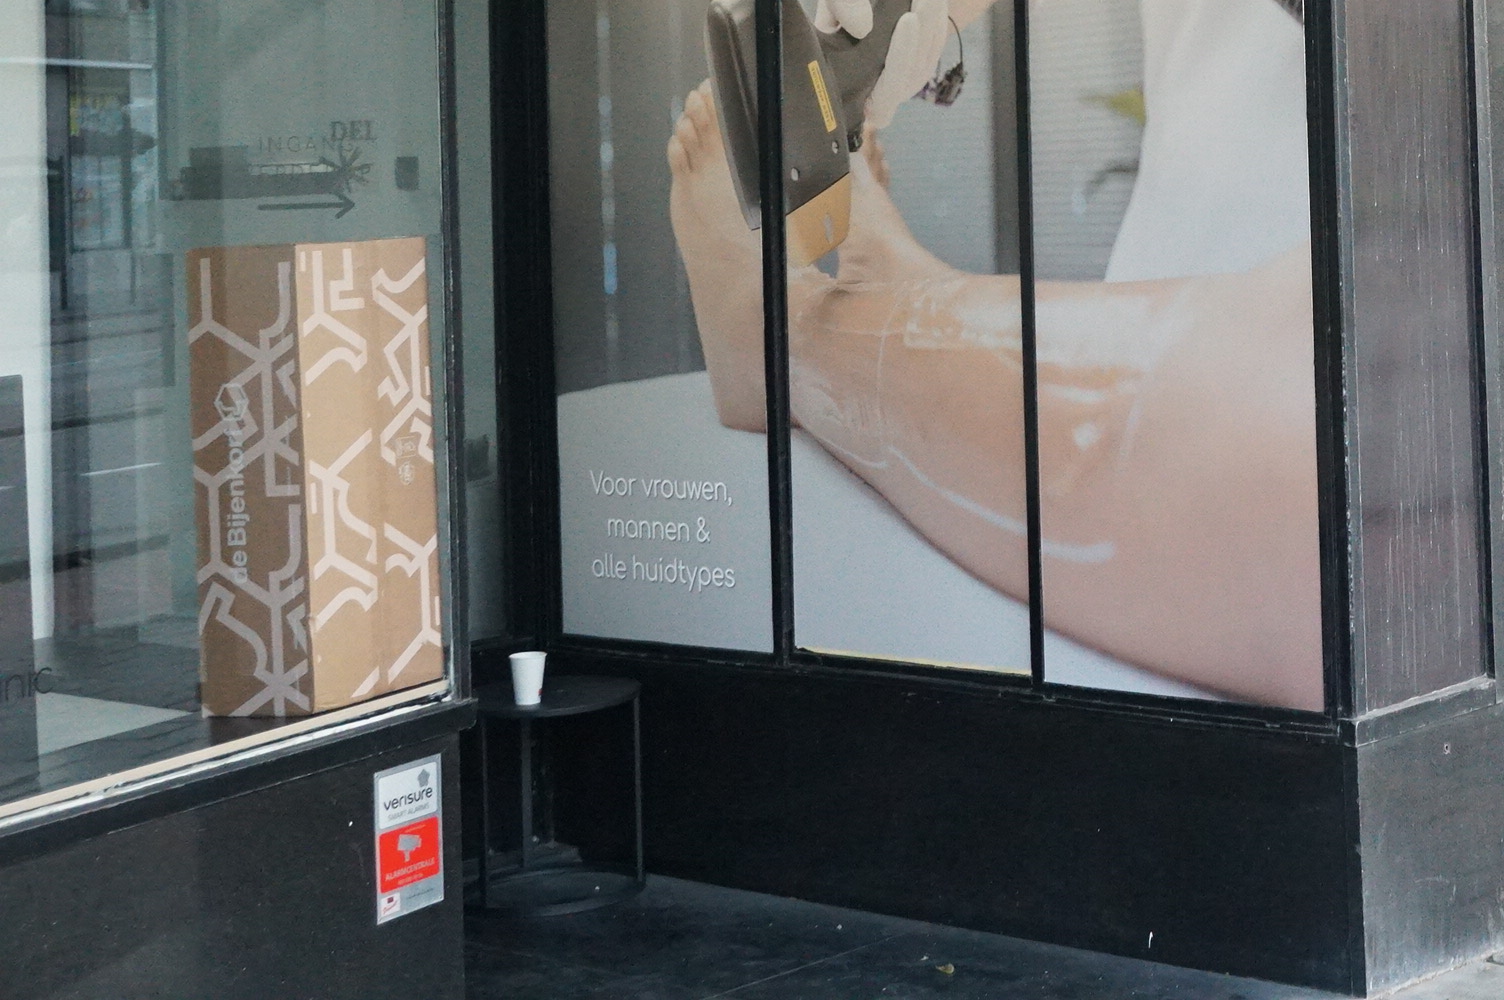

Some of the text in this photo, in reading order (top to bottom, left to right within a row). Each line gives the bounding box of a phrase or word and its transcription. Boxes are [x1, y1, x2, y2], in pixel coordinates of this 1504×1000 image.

[589, 470, 734, 506] Voor vrouwen,
[607, 516, 711, 543] mannen &
[591, 553, 736, 591] alle huidtypes
[383, 787, 433, 811] verisure
